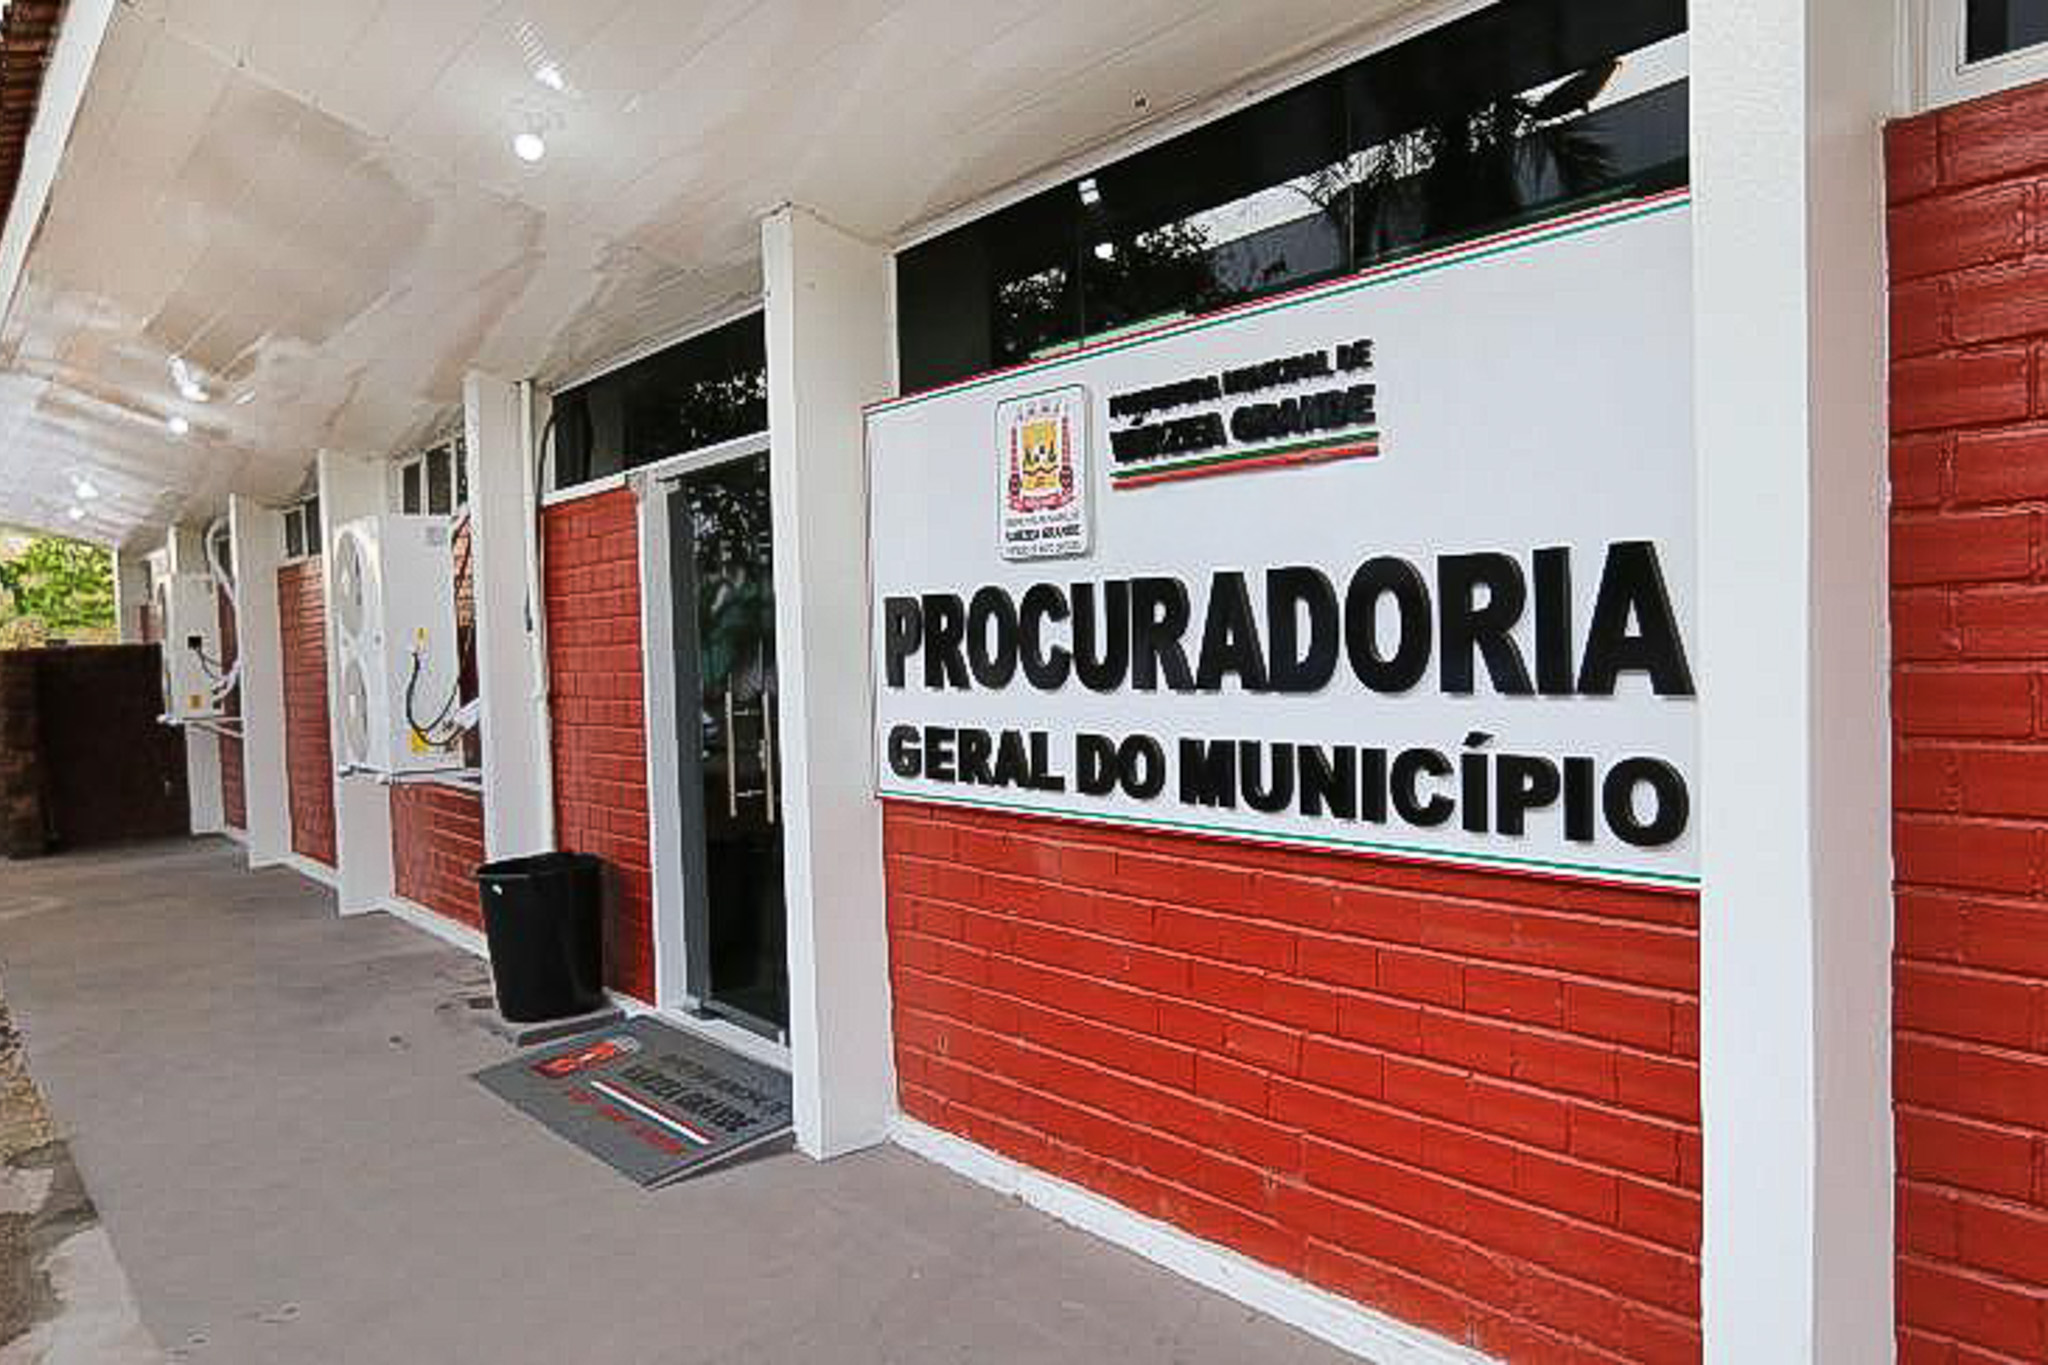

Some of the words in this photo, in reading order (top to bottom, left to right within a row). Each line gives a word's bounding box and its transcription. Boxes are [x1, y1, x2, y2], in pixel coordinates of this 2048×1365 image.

[884, 540, 1695, 699] PROCURADORIA
[888, 725, 1066, 793] GERAL
[1076, 733, 1166, 801] DO
[1179, 731, 1690, 848] MUNICÍPIO
